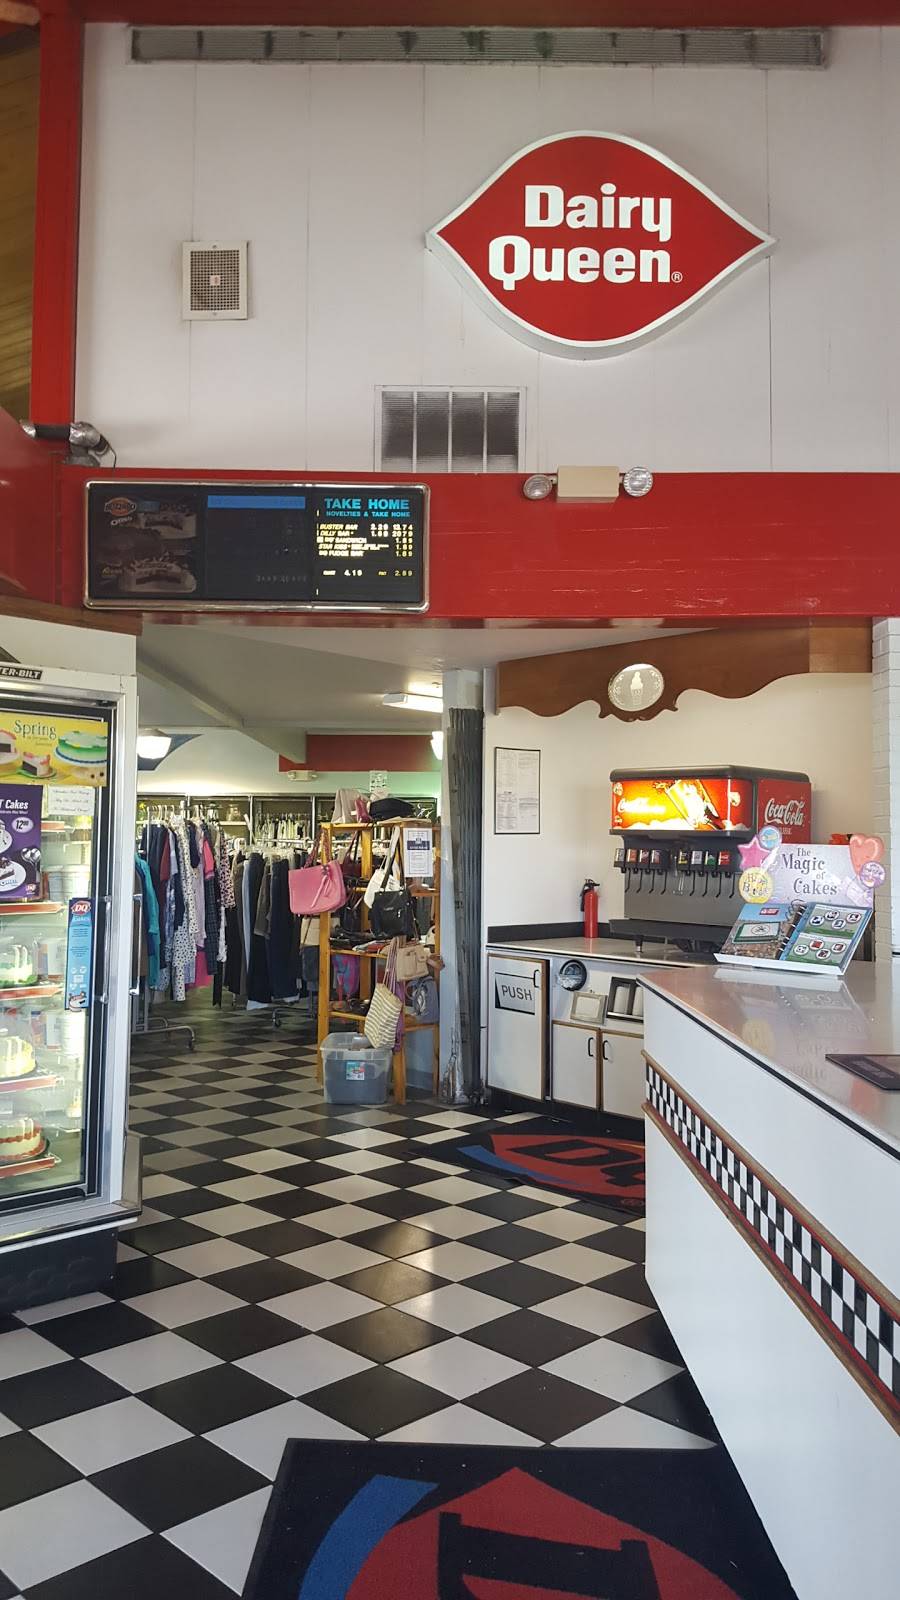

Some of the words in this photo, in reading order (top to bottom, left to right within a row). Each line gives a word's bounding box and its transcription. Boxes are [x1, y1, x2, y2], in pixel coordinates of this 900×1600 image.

[524, 183, 672, 242] Dairy
[324, 498, 361, 510] TAKE
[368, 498, 410, 510] HOME
[319, 523, 344, 531] BUSTER
[345, 523, 359, 531] BAR
[14, 719, 57, 740] Spring
[5, 799, 29, 810] Cakes
[797, 847, 811, 857] The
[781, 853, 826, 875] Magic
[815, 871, 826, 880] of
[793, 878, 838, 895] Cakes
[74, 903, 89, 913] DQ
[501, 985, 533, 1001] PUSH
